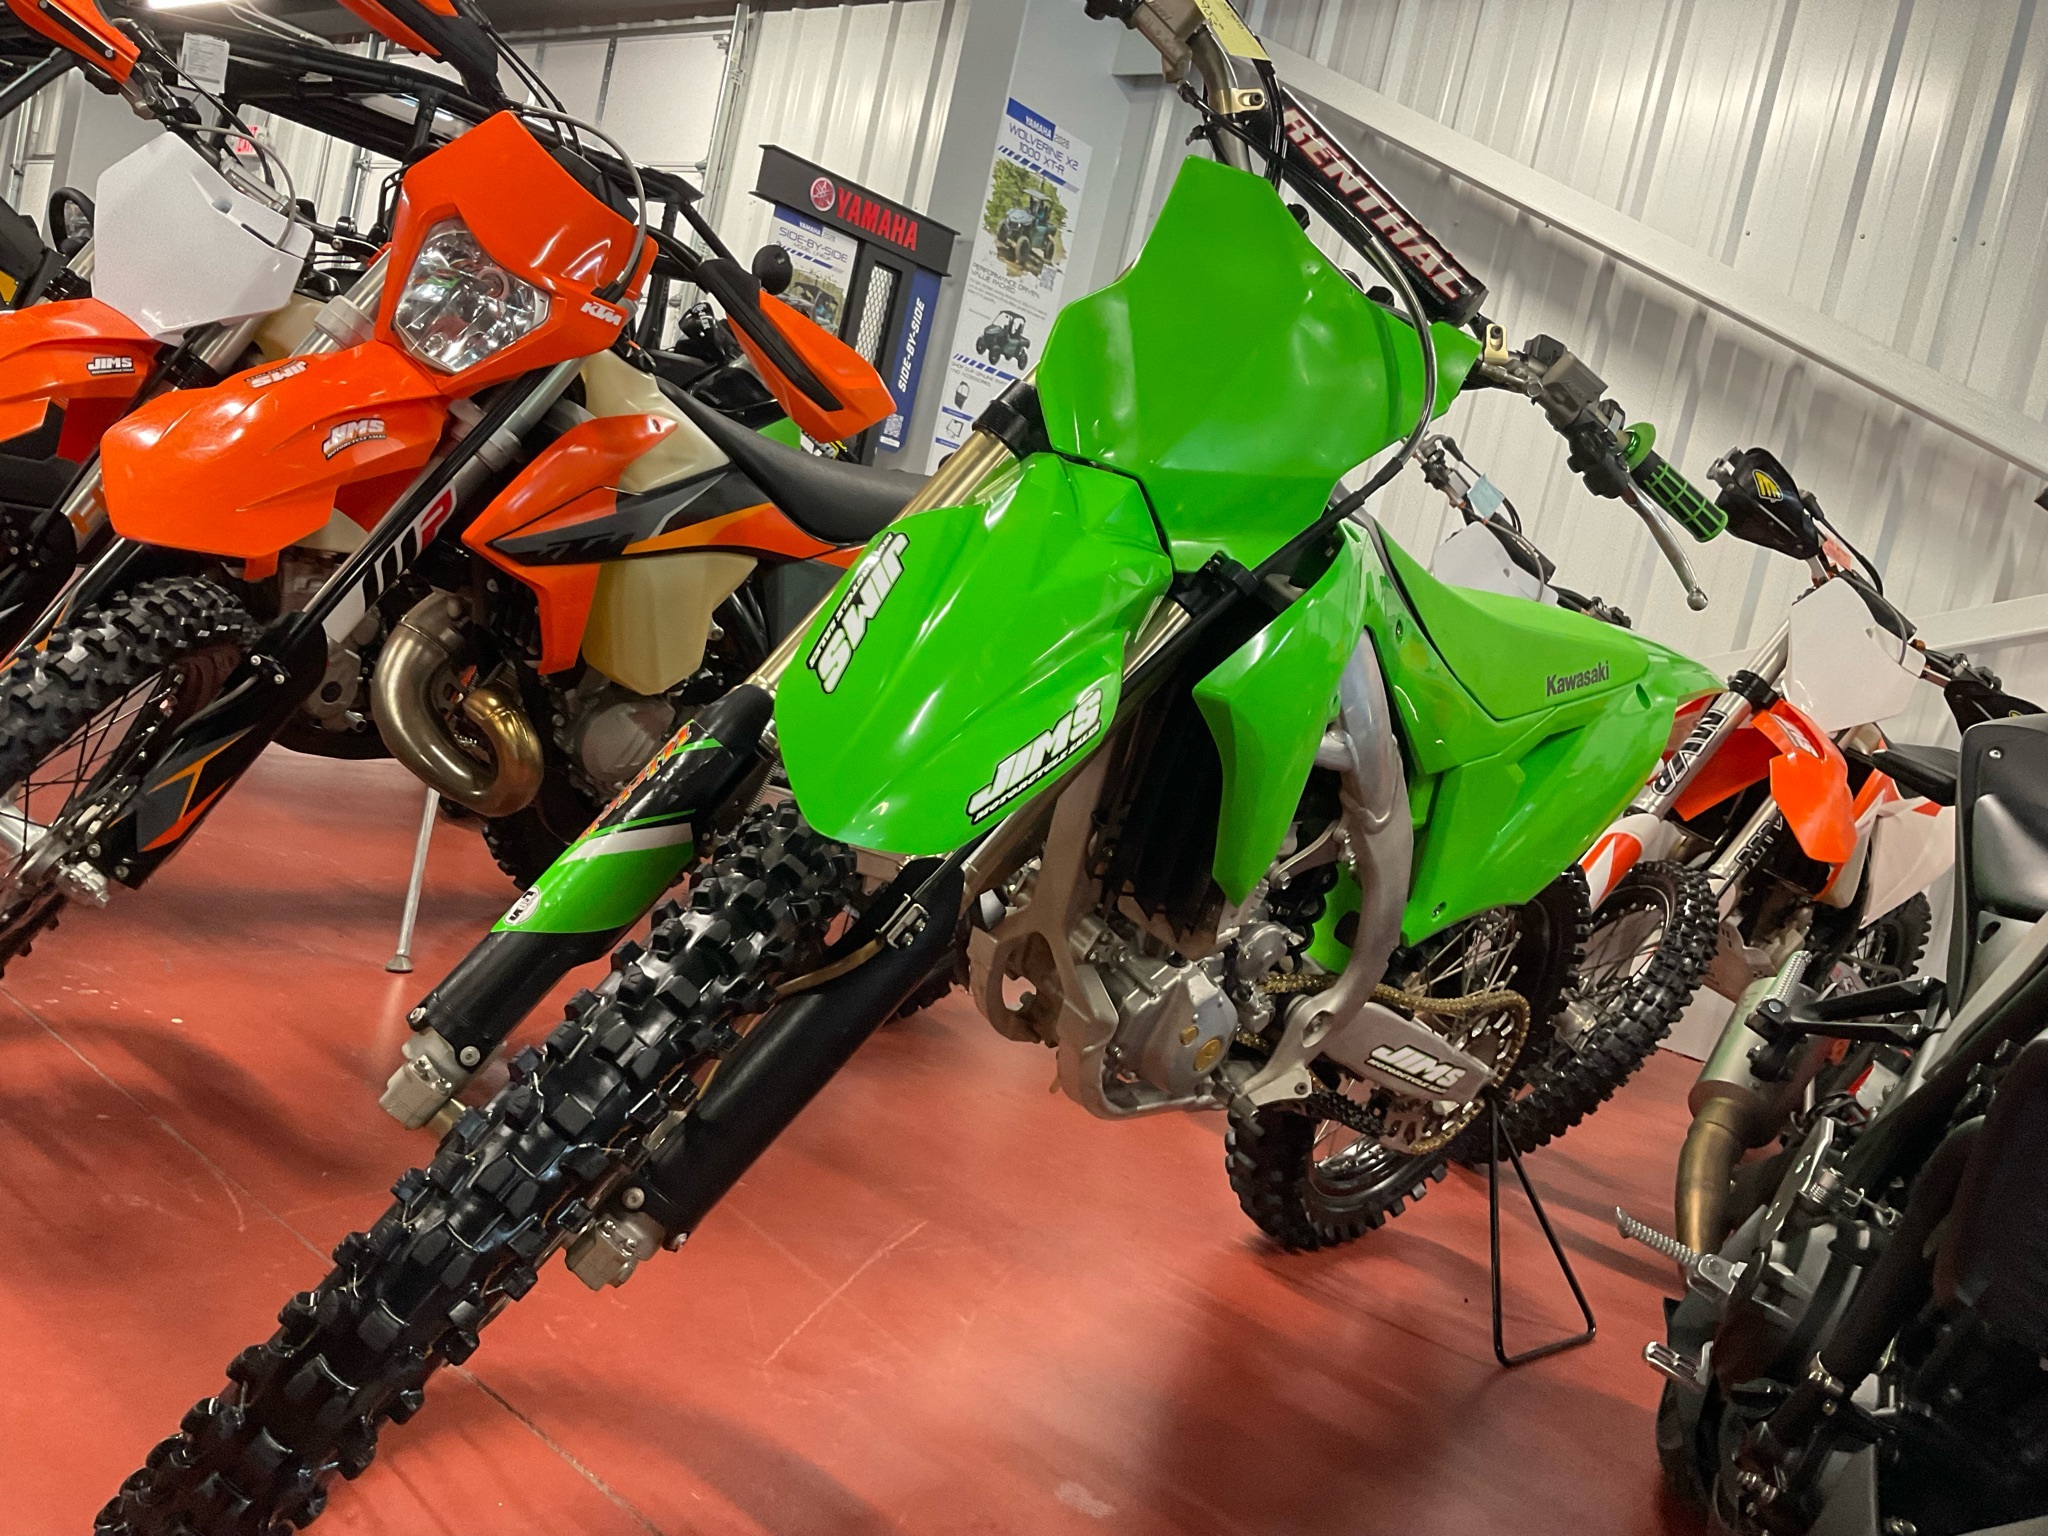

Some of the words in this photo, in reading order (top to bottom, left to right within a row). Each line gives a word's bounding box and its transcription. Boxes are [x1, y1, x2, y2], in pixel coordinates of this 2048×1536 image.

[1025, 116, 1052, 139] YAMAHA
[1009, 122, 1064, 161] WOLVERINE
[1066, 156, 1079, 171] X2
[1019, 141, 1041, 161] 1000
[1043, 156, 1065, 175] XT-R
[837, 187, 918, 252] YAMAHA
[1283, 108, 1463, 299] RENTHAL
[779, 226, 848, 263] SIDE-BY-SIDE
[799, 221, 821, 236] YAMAHA
[580, 301, 622, 326] KTM
[897, 297, 925, 393] SIDE-BY-SIDE
[88, 357, 133, 371] JIMS
[252, 361, 307, 388] JIMS
[323, 419, 385, 455] JIMS
[818, 533, 909, 693] JIMS
[1546, 660, 1609, 697] Kawasaki
[968, 689, 1102, 814] JIMS
[974, 752, 1068, 822] MOTORCYCLE
[1371, 1046, 1466, 1087] JIMS
